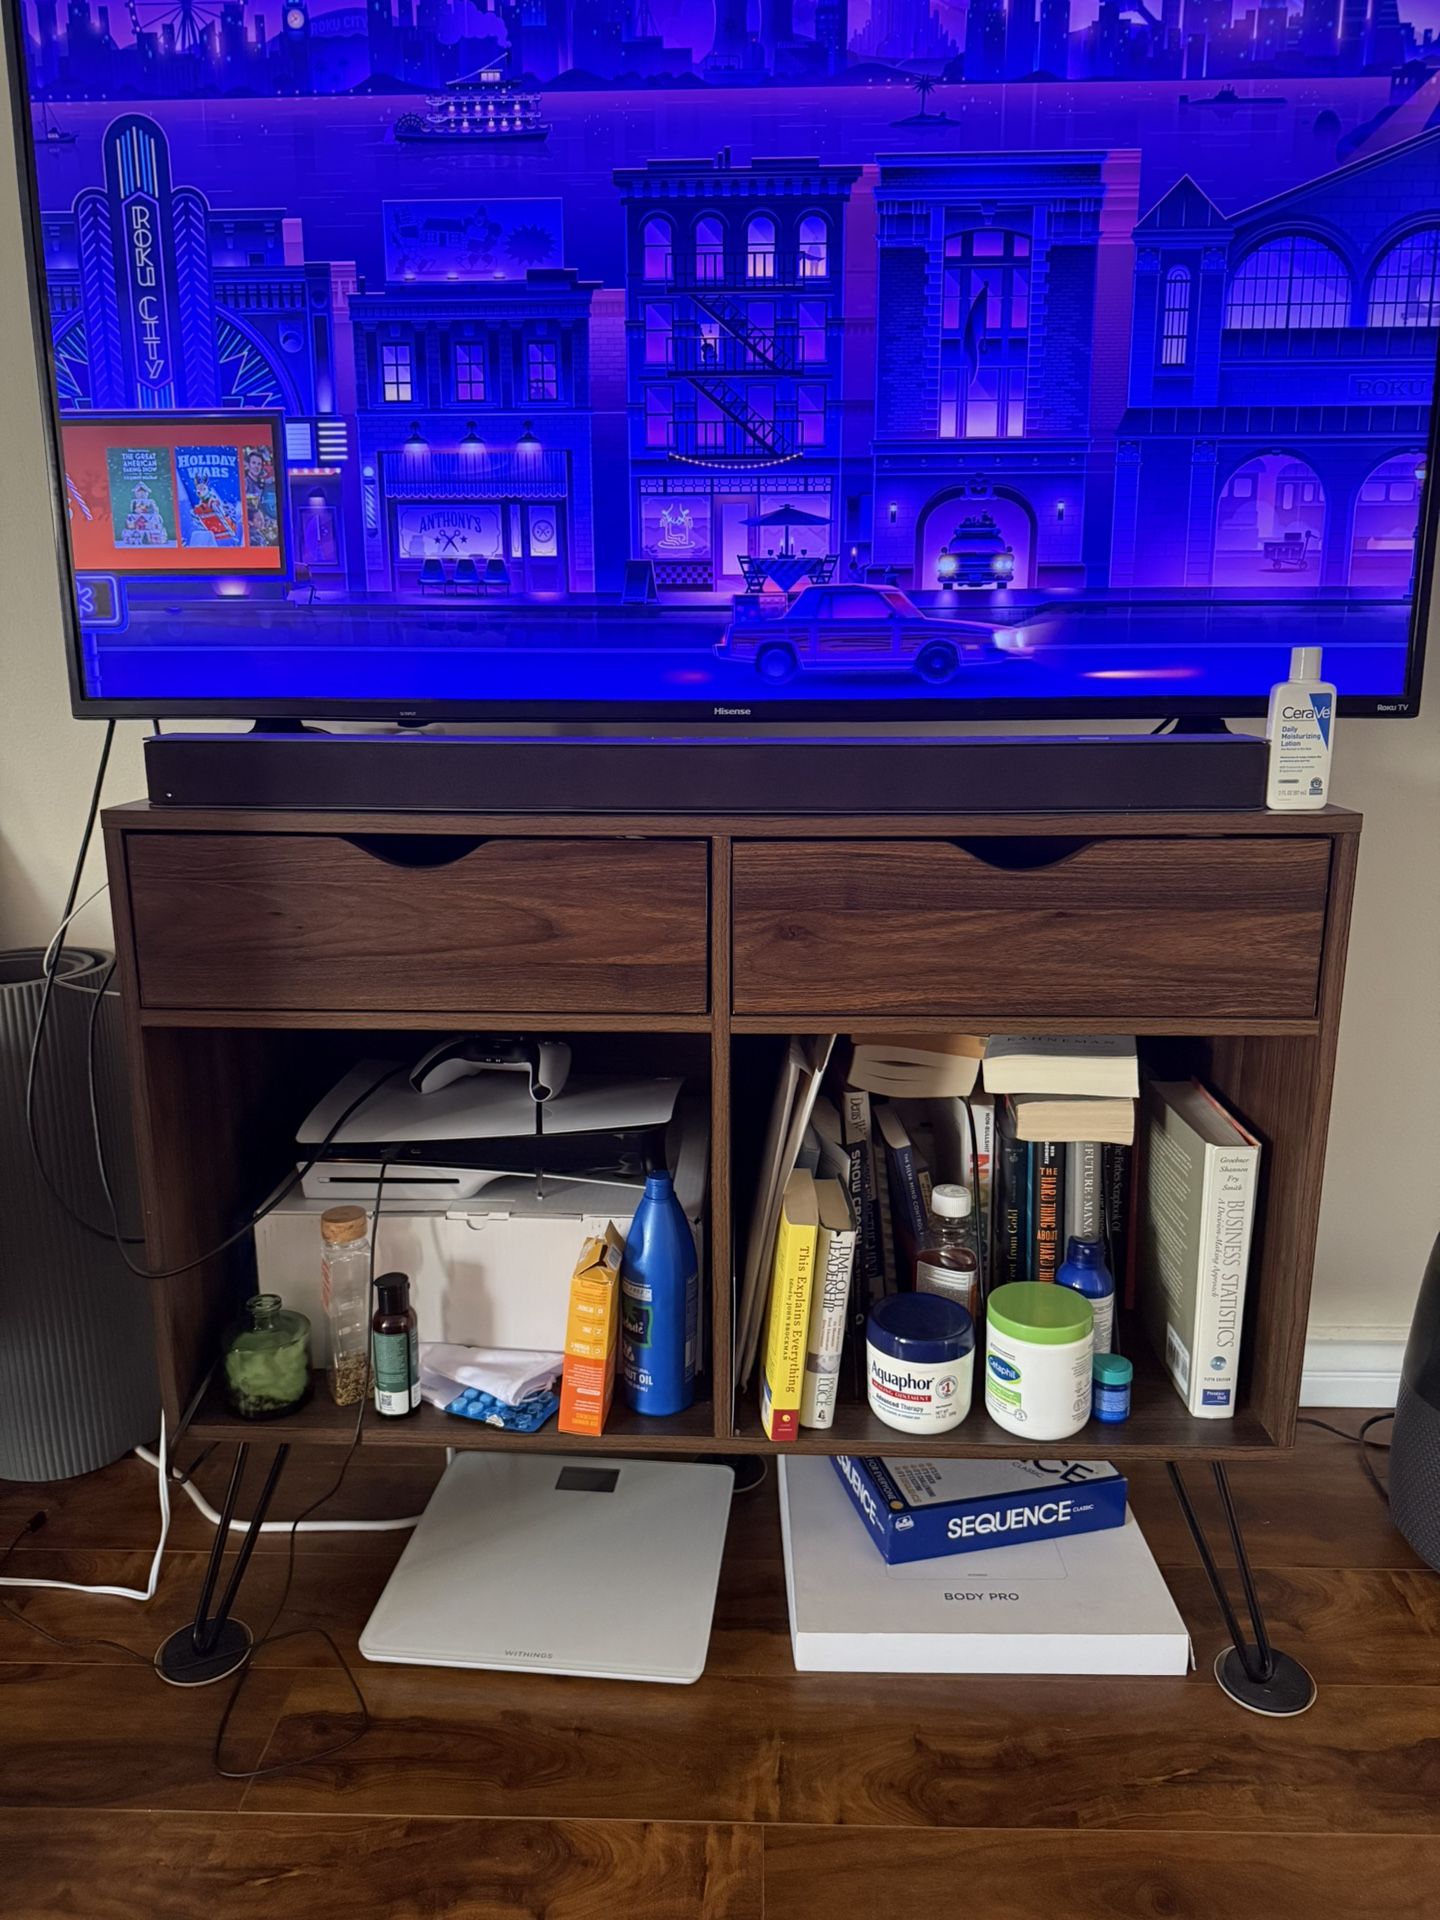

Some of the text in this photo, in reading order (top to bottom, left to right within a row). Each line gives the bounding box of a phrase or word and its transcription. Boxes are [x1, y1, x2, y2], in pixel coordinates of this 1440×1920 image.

[132, 206, 164, 379] ROKU CITY
[1355, 379, 1427, 397] ROKU
[178, 454, 236, 468] HOLIDAY
[187, 467, 229, 479] WARS
[419, 511, 482, 534] ANTHONY'S
[714, 707, 751, 715] Hisense
[1282, 706, 1331, 719] CeraVe
[1281, 733, 1321, 741] Moisturizing
[851, 1149, 862, 1193] SNOW
[905, 1163, 913, 1180] SILVA
[1040, 1167, 1058, 1175] THE
[1084, 1148, 1094, 1194] FUTURE
[1218, 1165, 1248, 1173] Shannon
[1227, 1175, 1239, 1183] Fry
[909, 1181, 918, 1200] MIND
[1110, 1182, 1122, 1220] Scrapbook
[1040, 1177, 1057, 1228] HARD THING
[913, 1200, 923, 1232] CONTROL
[1007, 1209, 1018, 1234] Gold
[1037, 1230, 1057, 1241] ABOUT
[1007, 1236, 1017, 1260] from
[1040, 1242, 1056, 1266] HARD
[823, 1240, 843, 1313] LEADERSHIP
[837, 1241, 852, 1309] TIME-OUT
[1210, 1265, 1220, 1297] Approach
[1217, 1200, 1245, 1348] BUSINESS STATISTICS
[785, 1246, 810, 1393] This Explains Everything
[782, 1323, 791, 1360] BROCKMAN
[639, 1374, 653, 1386] OIL
[872, 1360, 932, 1391] Aquaphor
[816, 1377, 829, 1406] LUCE
[876, 1393, 899, 1408] Advanced
[901, 1403, 923, 1412] Therapy
[895, 1392, 929, 1401] OINTMENT
[1012, 1461, 1045, 1479] CLASSIC
[947, 1500, 1094, 1539] SEQUENCE CLASSIC
[944, 1593, 1020, 1601] BODY PRO
[505, 1649, 553, 1659] WITHINGS
